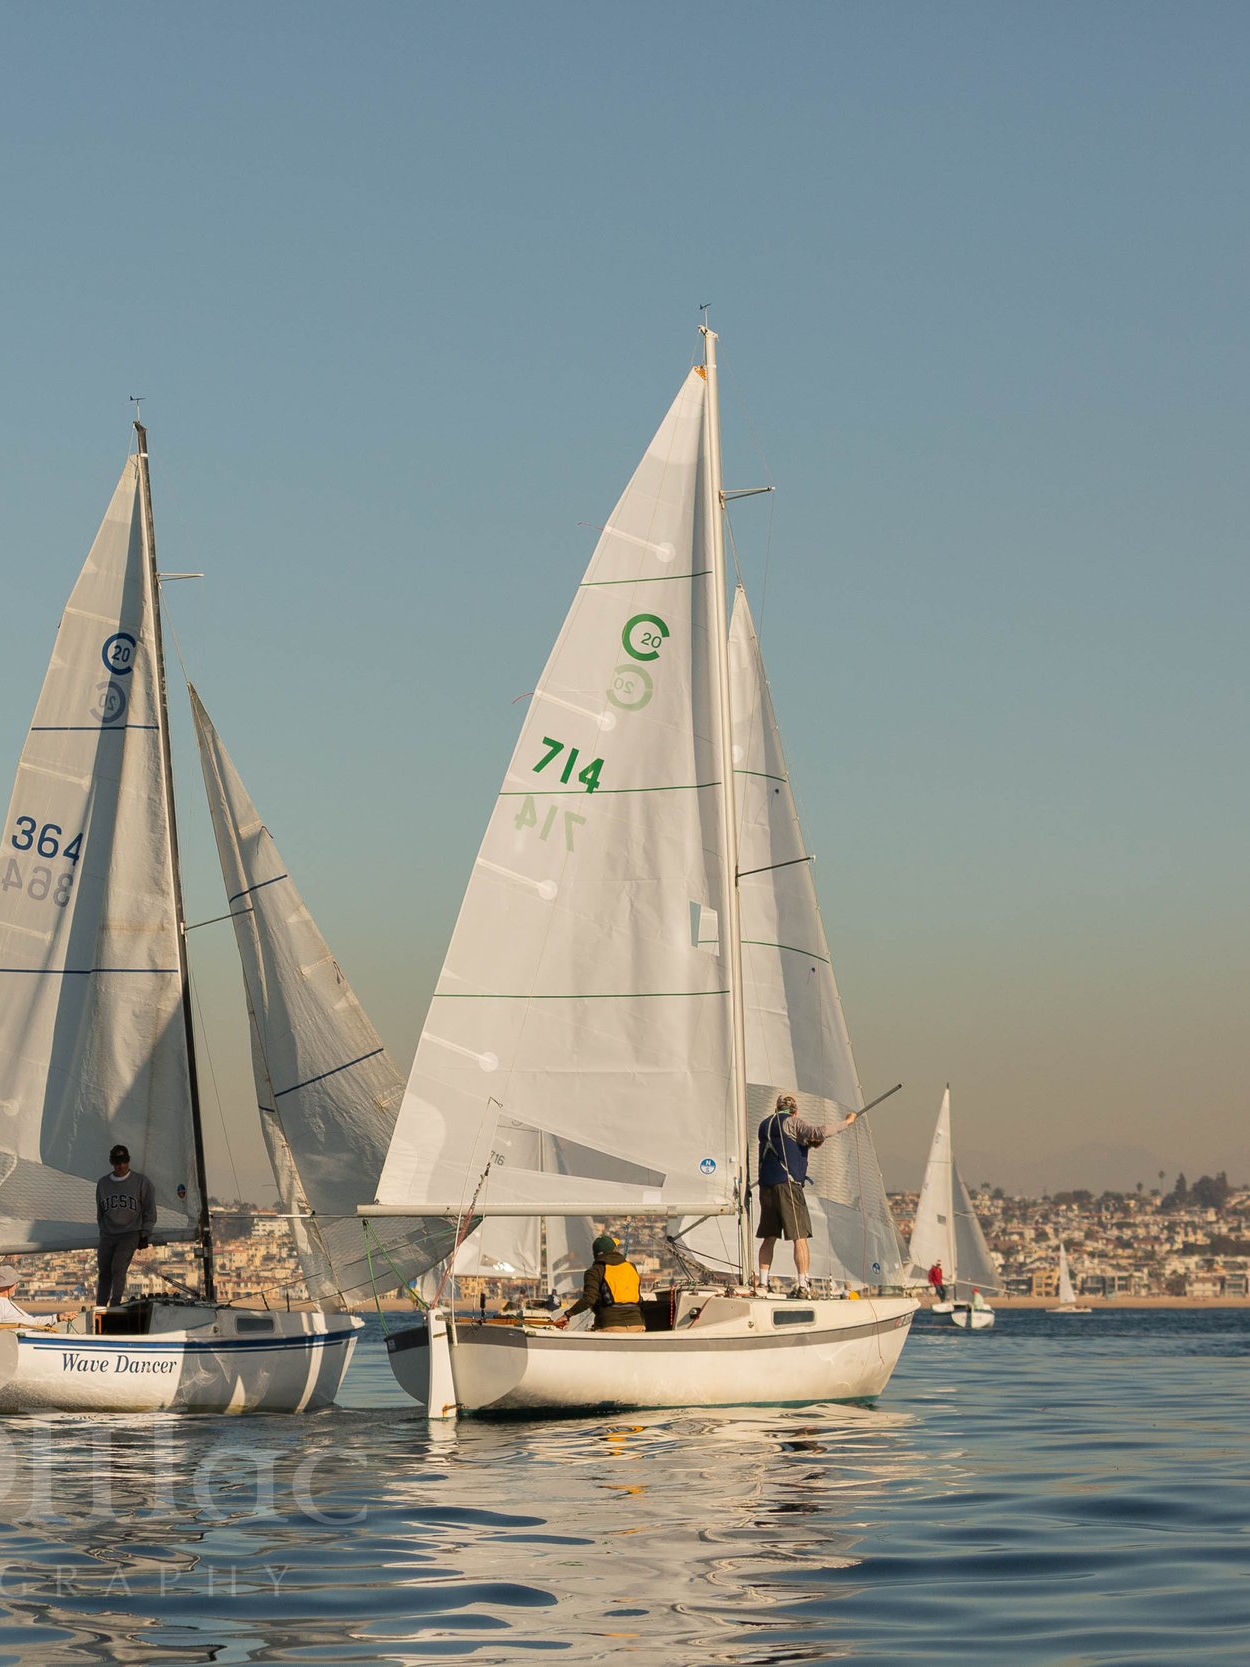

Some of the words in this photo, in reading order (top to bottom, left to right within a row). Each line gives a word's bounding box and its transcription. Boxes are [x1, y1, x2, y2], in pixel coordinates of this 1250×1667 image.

[641, 632, 662, 649] 20
[111, 644, 131, 663] 20
[532, 736, 605, 794] 714
[11, 815, 84, 866] 364
[491, 1150, 505, 1166] 716
[101, 1194, 137, 1212] UCSD
[62, 1352, 109, 1373] Wave
[113, 1354, 177, 1374] Dancer
